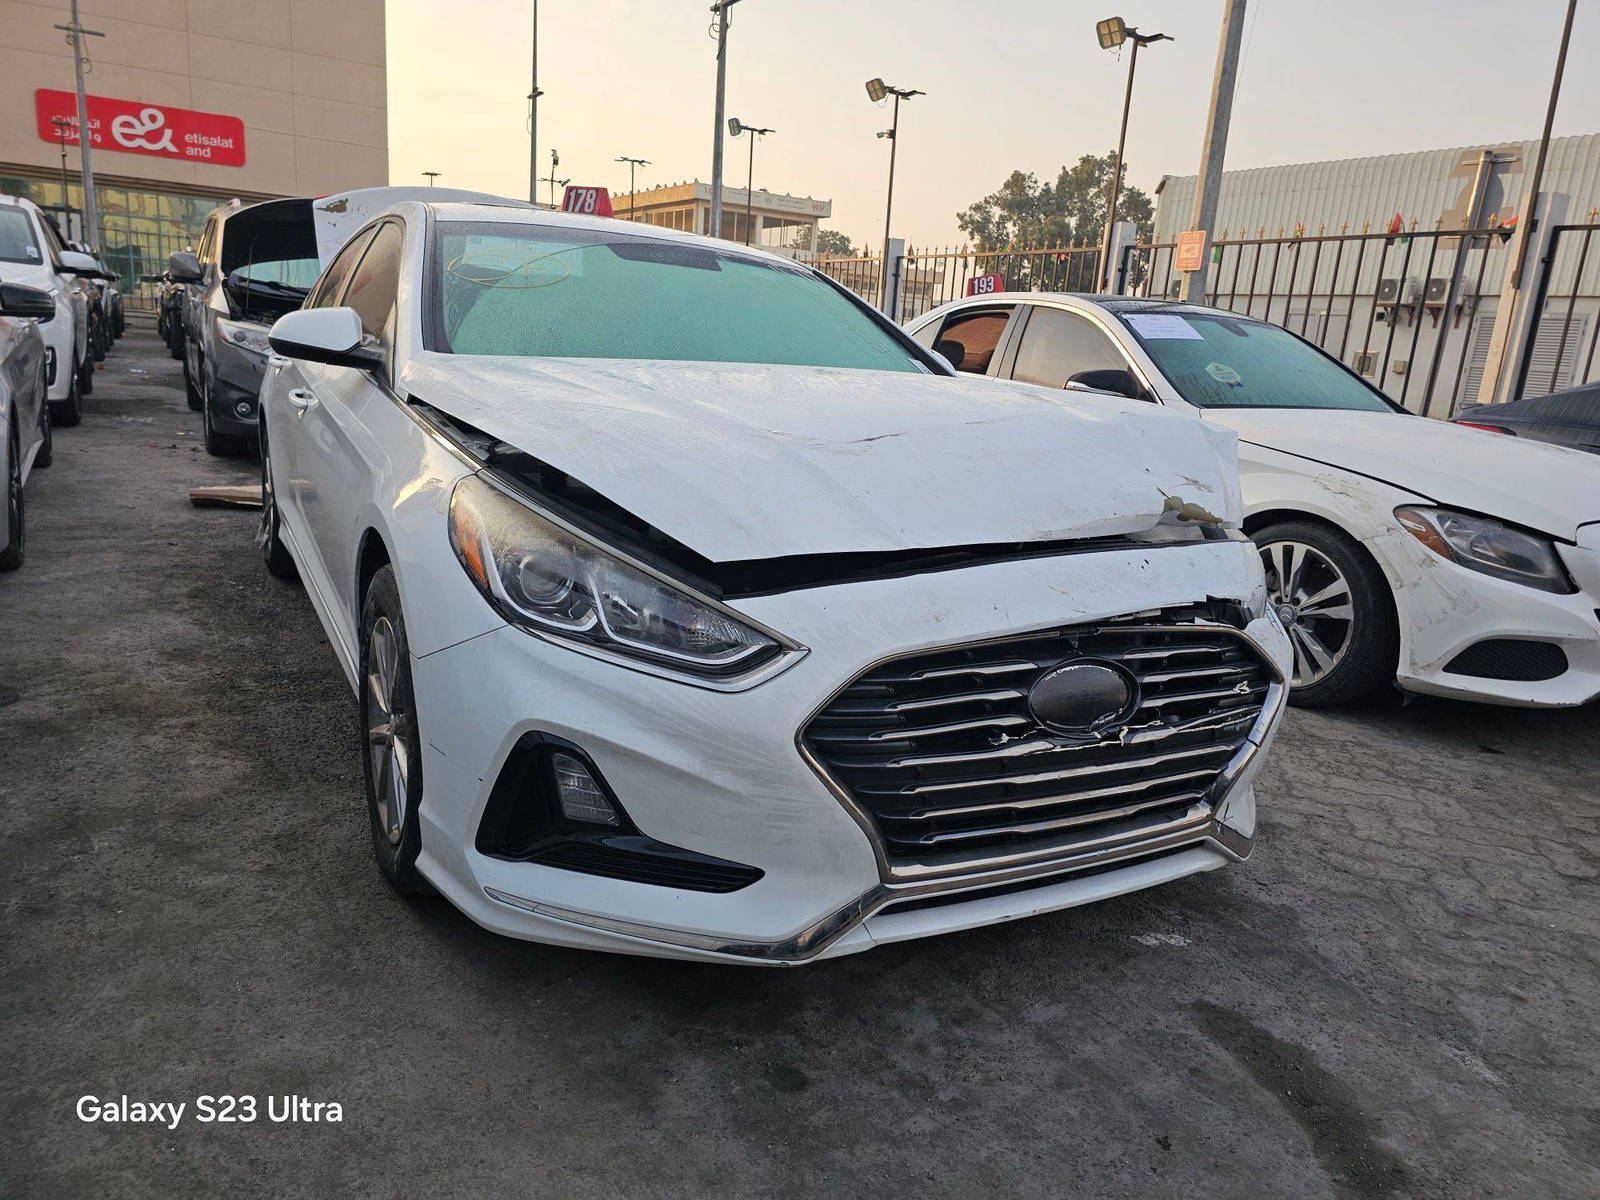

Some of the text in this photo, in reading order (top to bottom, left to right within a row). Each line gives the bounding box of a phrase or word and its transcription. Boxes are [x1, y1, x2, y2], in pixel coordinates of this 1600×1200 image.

[185, 132, 235, 149] etisalat
[185, 147, 212, 158] and
[568, 189, 597, 213] 178
[973, 276, 995, 295] 193
